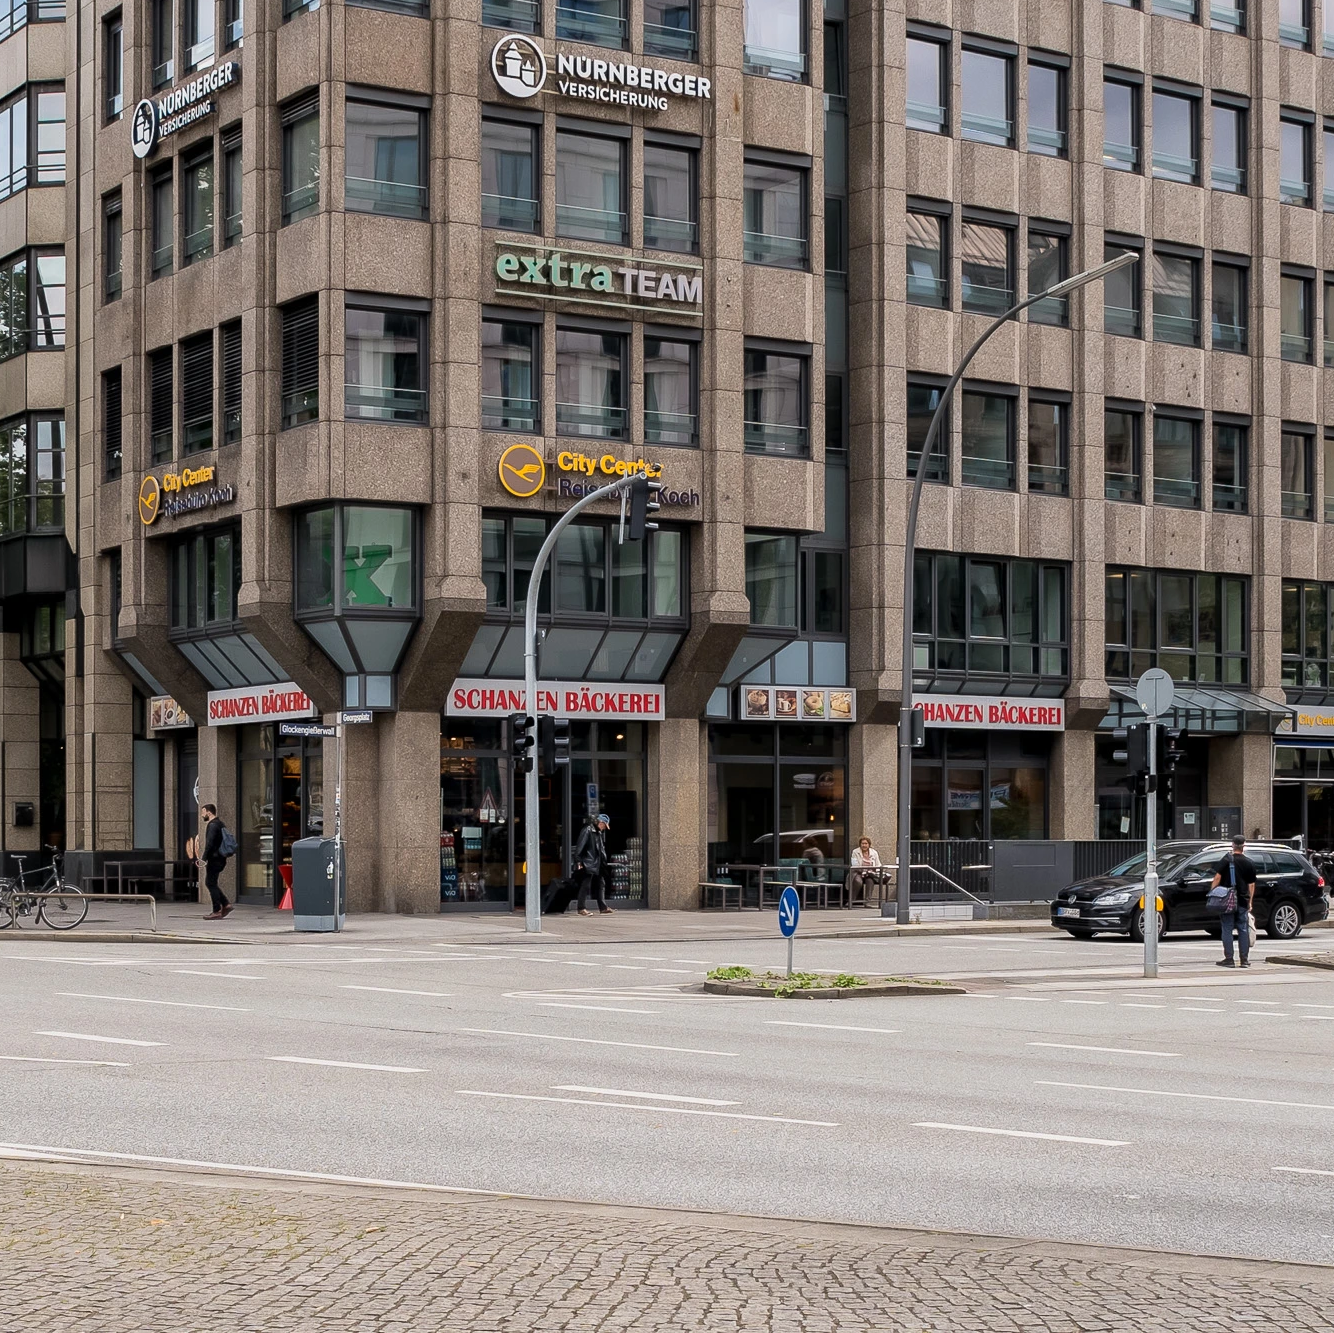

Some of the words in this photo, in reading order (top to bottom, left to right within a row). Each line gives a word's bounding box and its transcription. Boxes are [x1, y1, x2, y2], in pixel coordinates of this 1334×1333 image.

[558, 53, 711, 98] NÜRNBERGER
[559, 81, 667, 110] VERSICHERUNG
[159, 100, 211, 137] VERSICHERUNG
[558, 452, 597, 476] City
[163, 474, 181, 492] City
[183, 466, 214, 487] Center
[210, 484, 233, 504] Koch
[656, 486, 699, 505] Koch
[210, 696, 258, 719] SCHANZEN
[262, 689, 310, 714] BÄCKEREI
[566, 687, 660, 713] BÄCKEREI
[914, 703, 983, 722] HANZEN
[989, 702, 1061, 725] BÄCKEREI
[1299, 714, 1314, 727] City
[282, 725, 335, 736] Glockengießerwall
